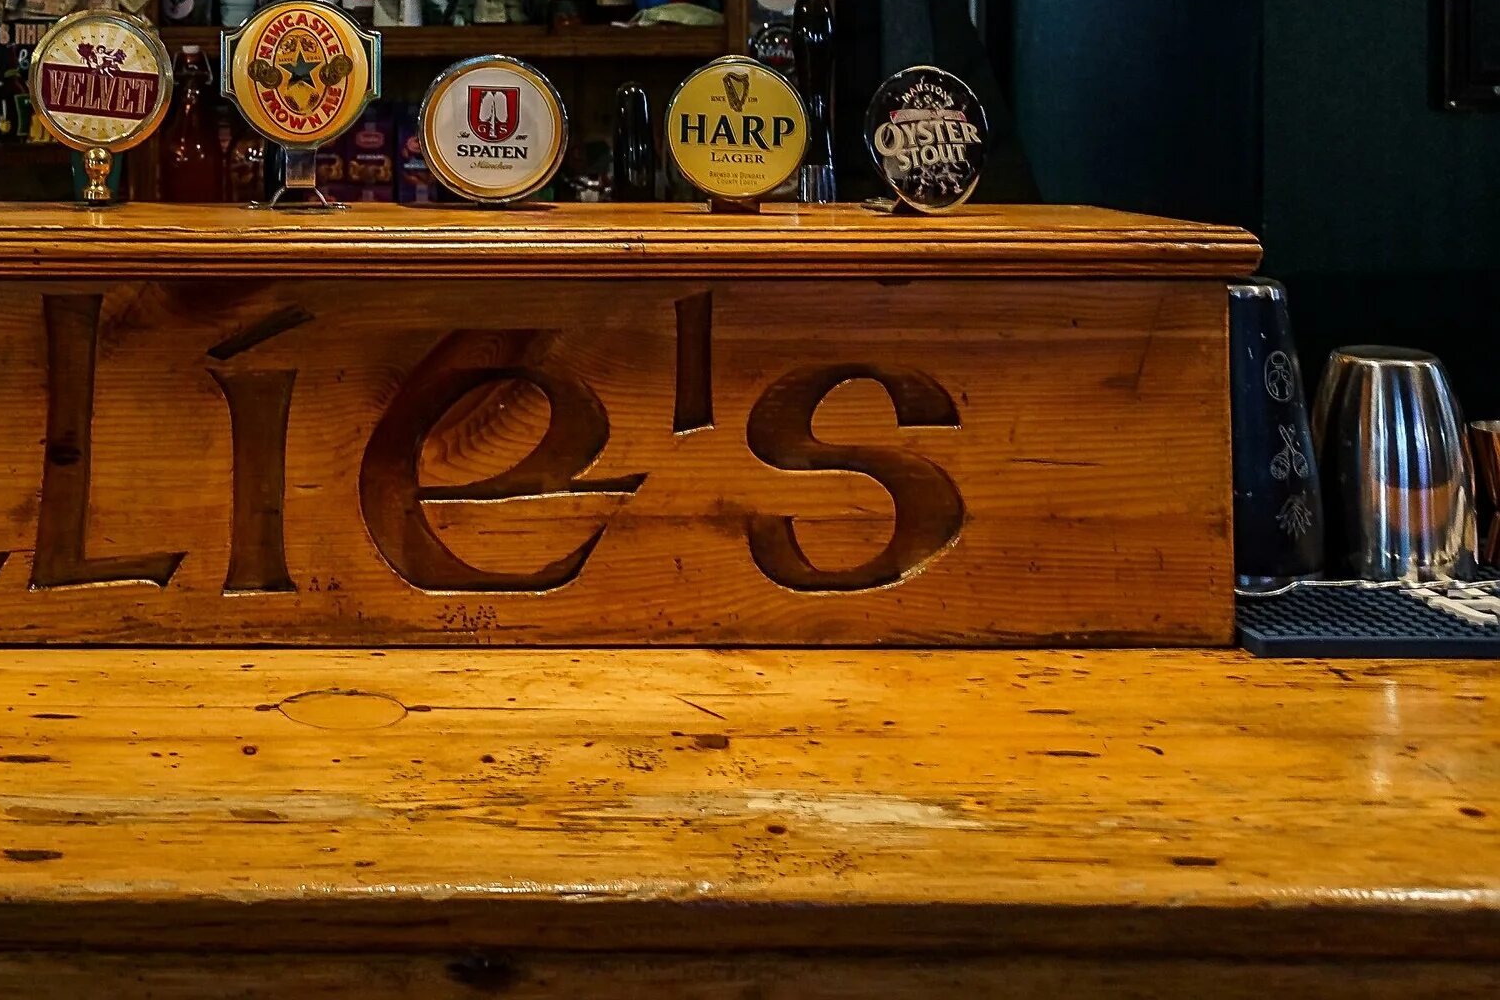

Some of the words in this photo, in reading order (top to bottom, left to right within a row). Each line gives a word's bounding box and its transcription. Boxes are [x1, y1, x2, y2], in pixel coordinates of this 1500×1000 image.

[258, 12, 341, 60] NEWCASTLE
[48, 68, 154, 115] VELVET
[261, 90, 322, 130] BROWN
[321, 86, 342, 118] ALE
[680, 113, 796, 152] HARP
[874, 120, 982, 157] OYSTER
[456, 144, 528, 160] SPATEN
[710, 152, 765, 164] LAGER
[896, 143, 967, 171] STOUT
